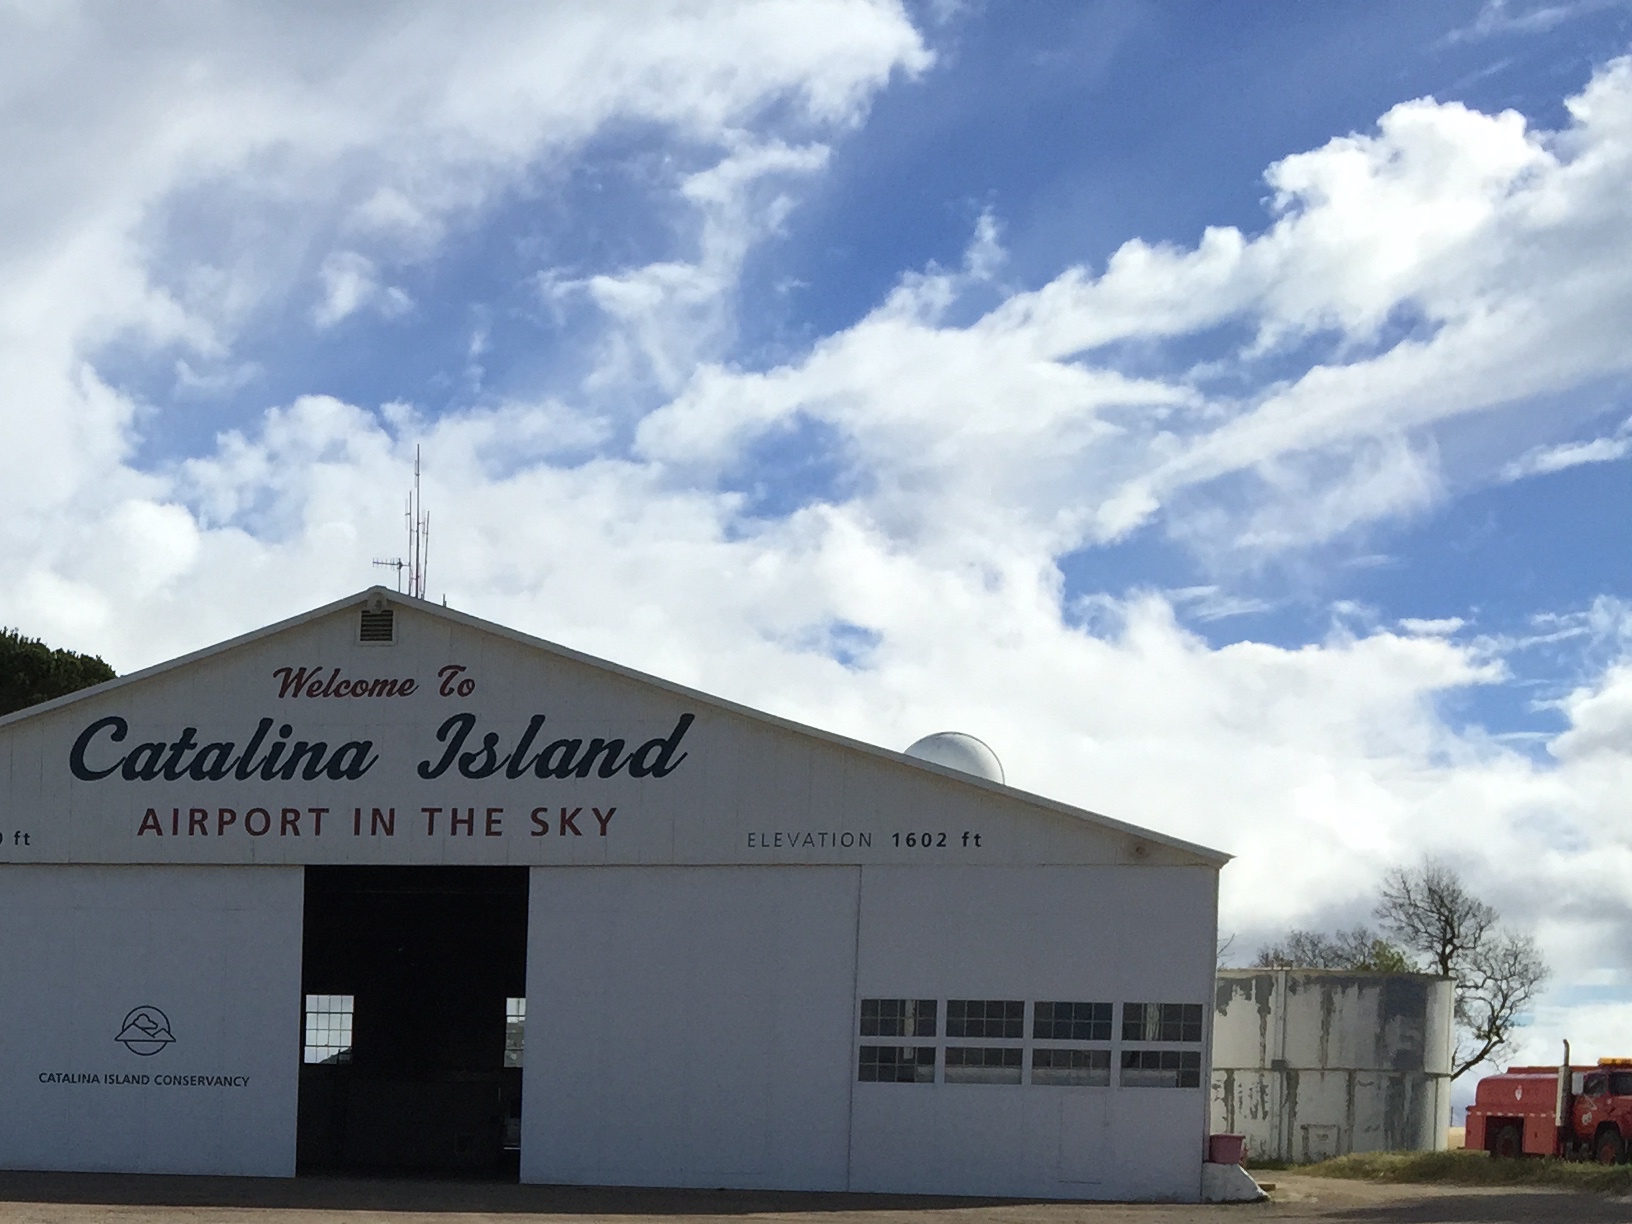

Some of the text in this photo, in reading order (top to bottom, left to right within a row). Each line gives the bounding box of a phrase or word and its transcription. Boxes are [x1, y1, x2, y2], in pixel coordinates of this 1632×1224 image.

[272, 664, 476, 699] Welcome To
[69, 712, 696, 782] Catalina Island
[136, 806, 618, 837] AIRPORT IN THE SKY
[13, 829, 32, 846] ft
[746, 830, 983, 849] ELEVATION 1602 ft
[38, 1071, 250, 1088] CATALINA ISLAND CONSERVANCY
